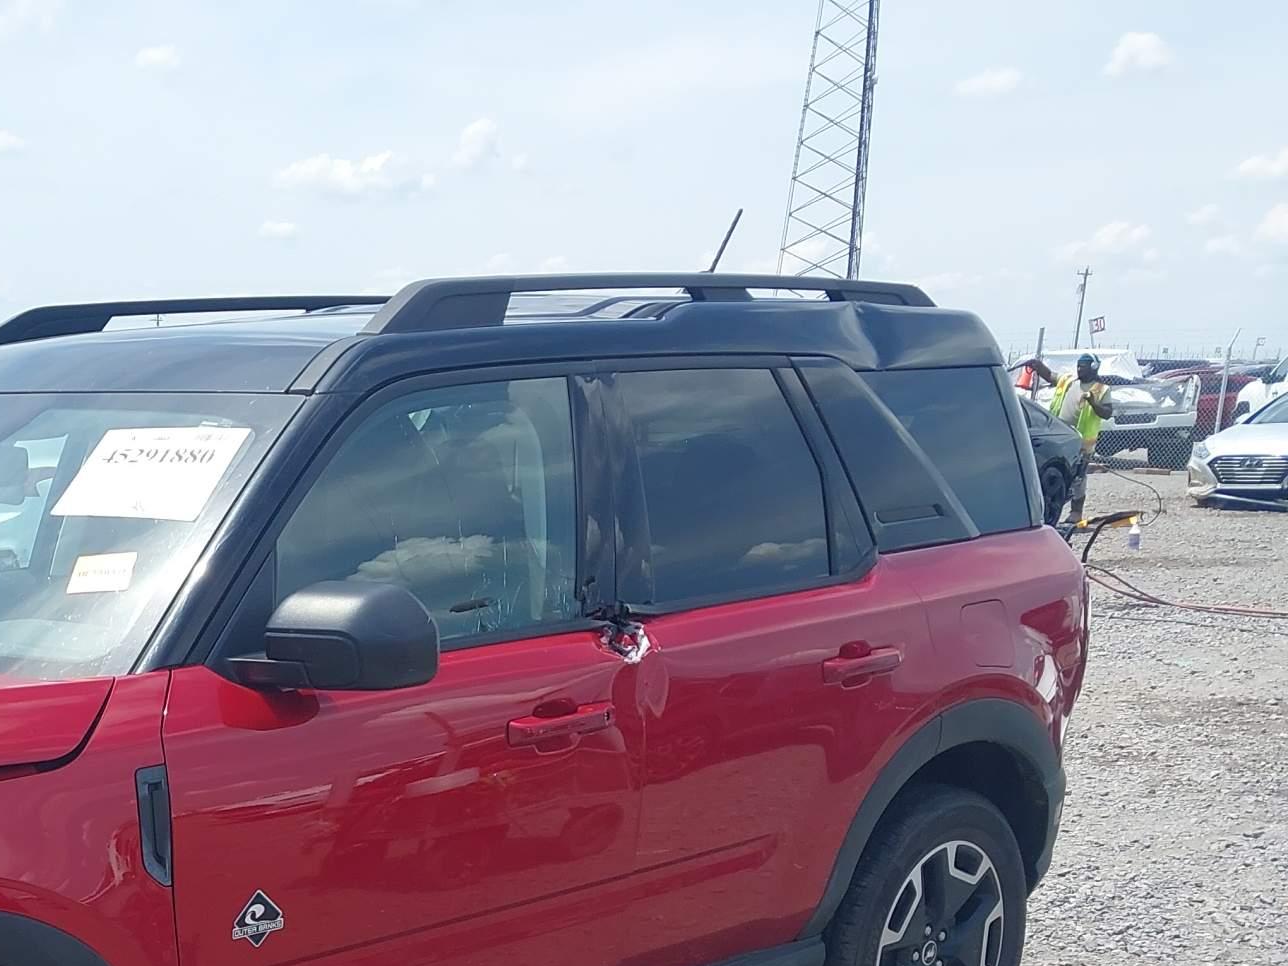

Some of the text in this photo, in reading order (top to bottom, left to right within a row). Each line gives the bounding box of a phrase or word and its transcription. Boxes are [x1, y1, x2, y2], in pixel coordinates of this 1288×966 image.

[102, 448, 216, 464] 45291880
[234, 919, 282, 938] OUTER BANKS
